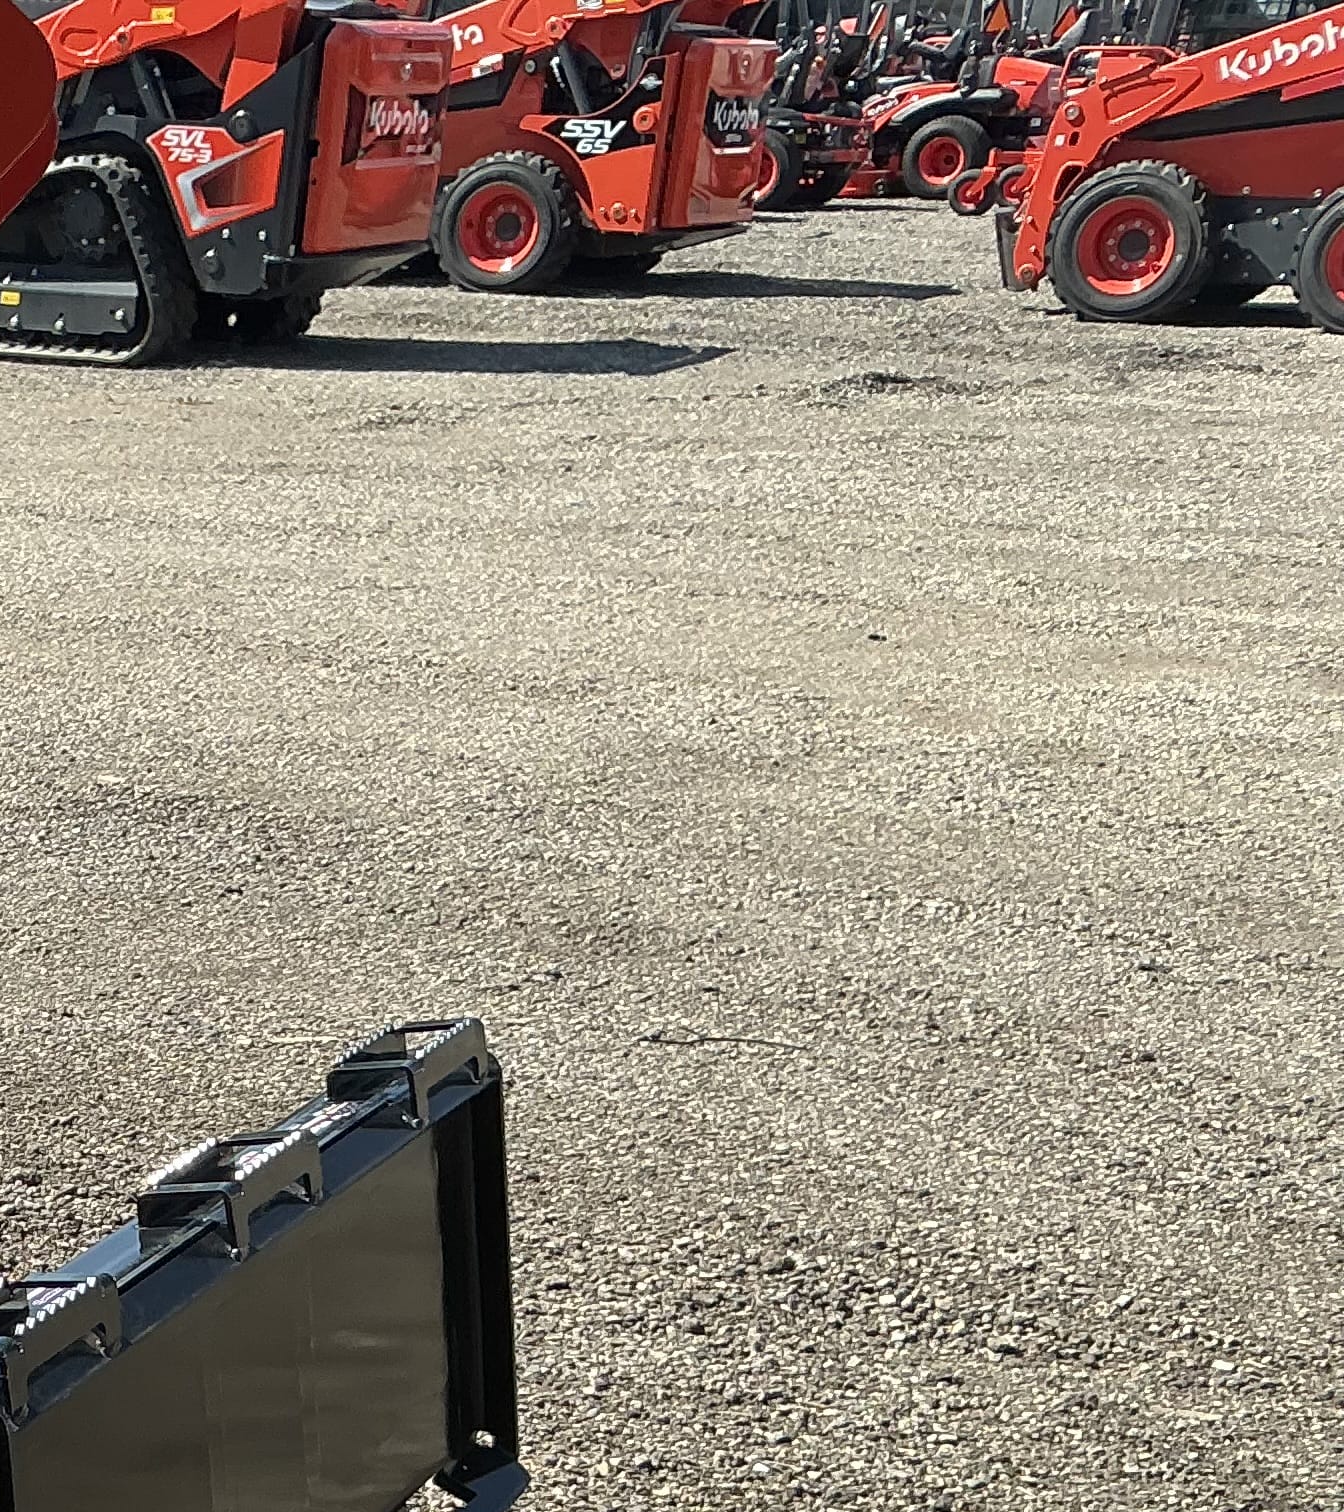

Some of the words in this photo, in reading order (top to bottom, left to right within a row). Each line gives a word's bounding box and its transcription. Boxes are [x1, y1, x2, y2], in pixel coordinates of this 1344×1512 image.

[370, 99, 429, 136] Kubota
[713, 100, 759, 131] Kubota
[161, 128, 211, 147] SVL
[560, 119, 627, 138] SSV
[167, 147, 213, 163] 75-3
[575, 138, 613, 155] 65
